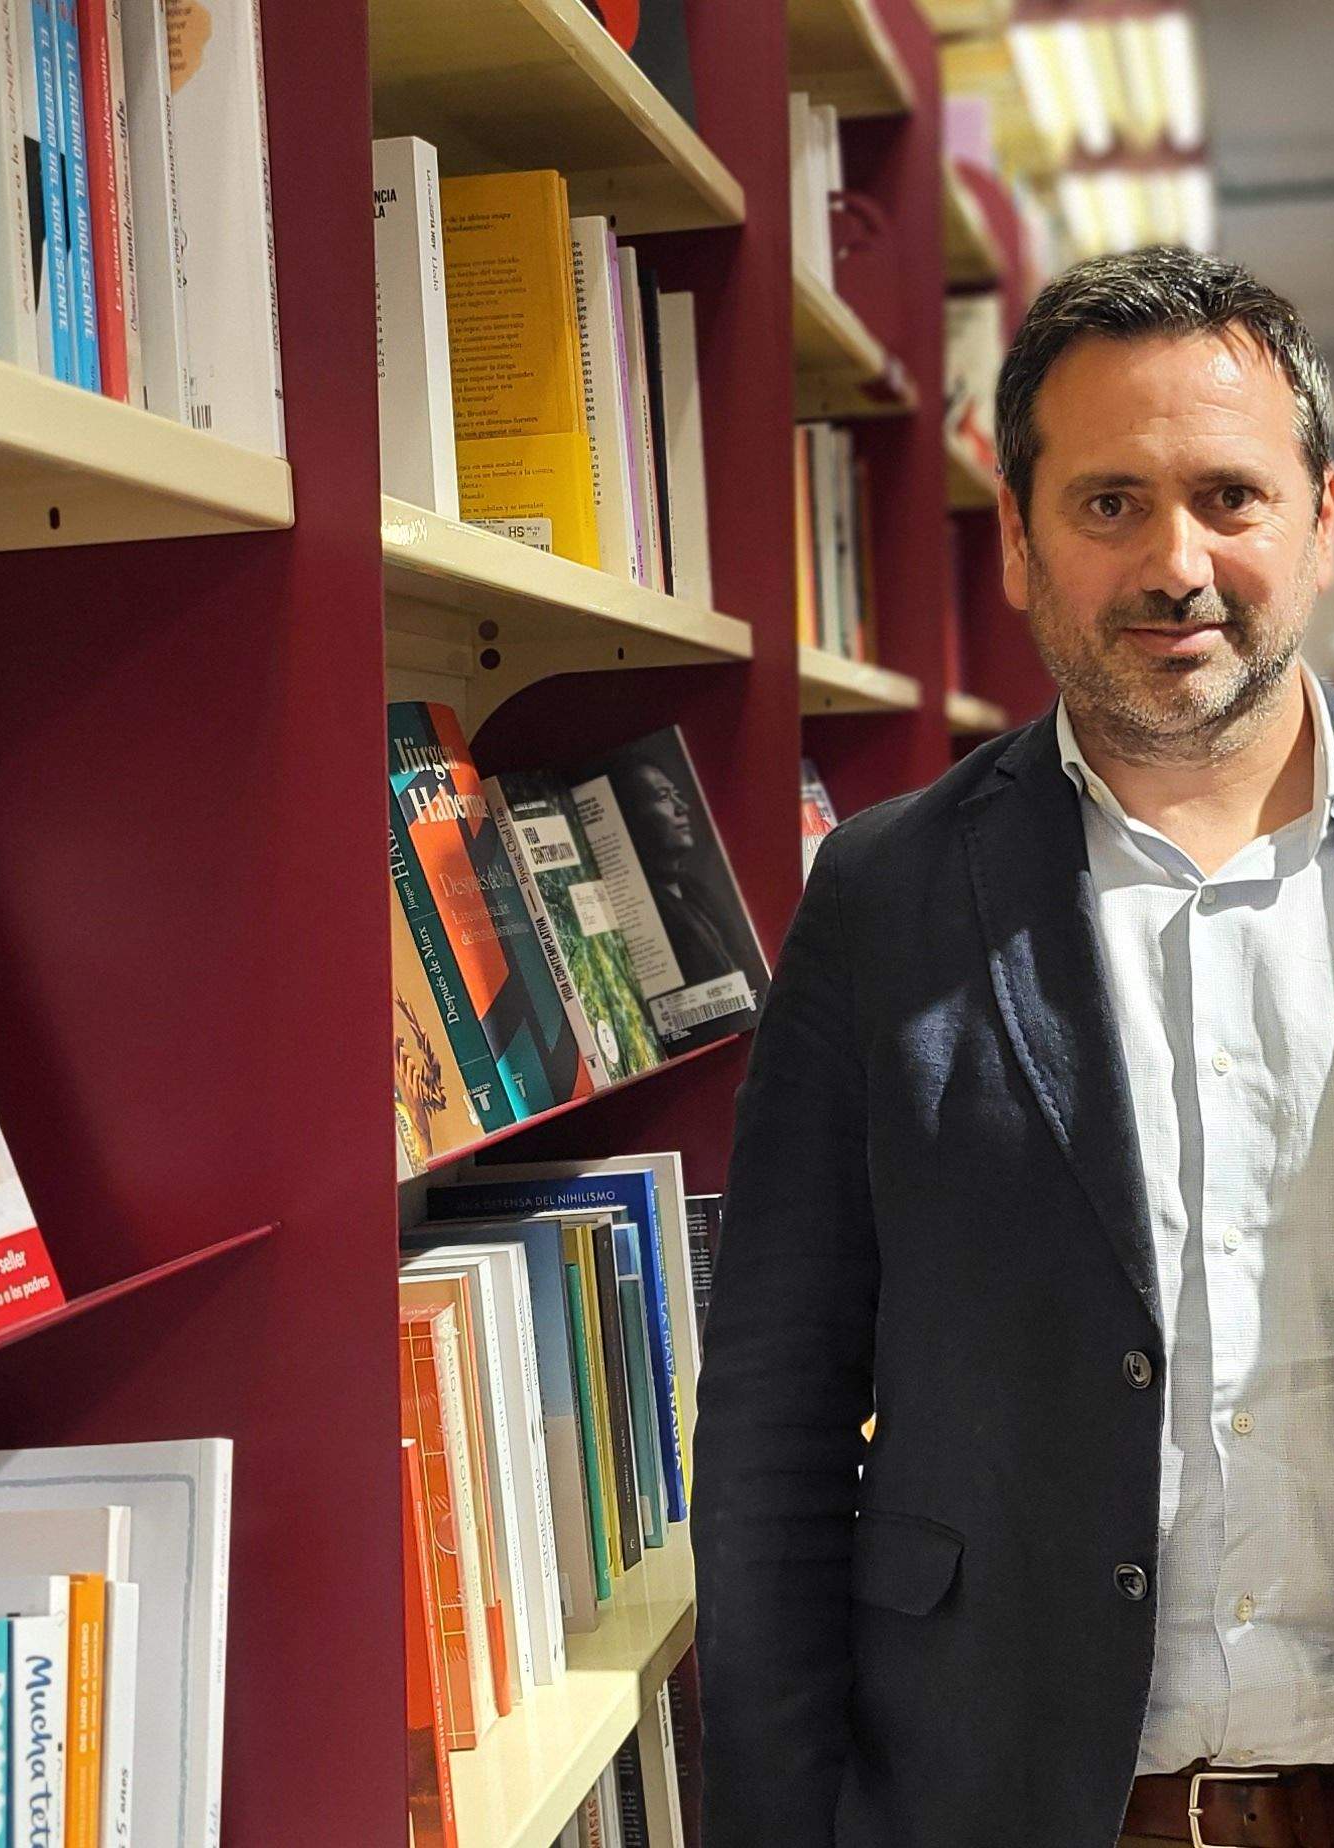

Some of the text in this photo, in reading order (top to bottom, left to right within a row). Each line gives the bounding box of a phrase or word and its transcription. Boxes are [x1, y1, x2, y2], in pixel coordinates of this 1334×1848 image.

[42, 56, 57, 148] CEREBRO
[48, 151, 59, 185] DEL
[66, 41, 96, 341] EL CEREBRO DEL ADOLESCENTE
[171, 199, 179, 222] DEL
[50, 196, 69, 331] ADOLESCENTE
[173, 227, 181, 264] SIGLO
[175, 267, 184, 288] XXI
[508, 525, 525, 538] HS
[394, 736, 460, 781] Jürgen
[419, 926, 460, 1026] Después de Marx
[535, 916, 575, 1004] VIDA CONTEMPLATIVA
[535, 1190, 616, 1206] DEL NIHILISMO
[4, 1291, 12, 1303] a
[11, 1284, 23, 1302] los
[21, 1273, 51, 1298] padres
[78, 1621, 90, 1753] DE UNO A CUATRO
[25, 1654, 54, 1848] Mucha tet
[115, 1818, 127, 1836] 5
